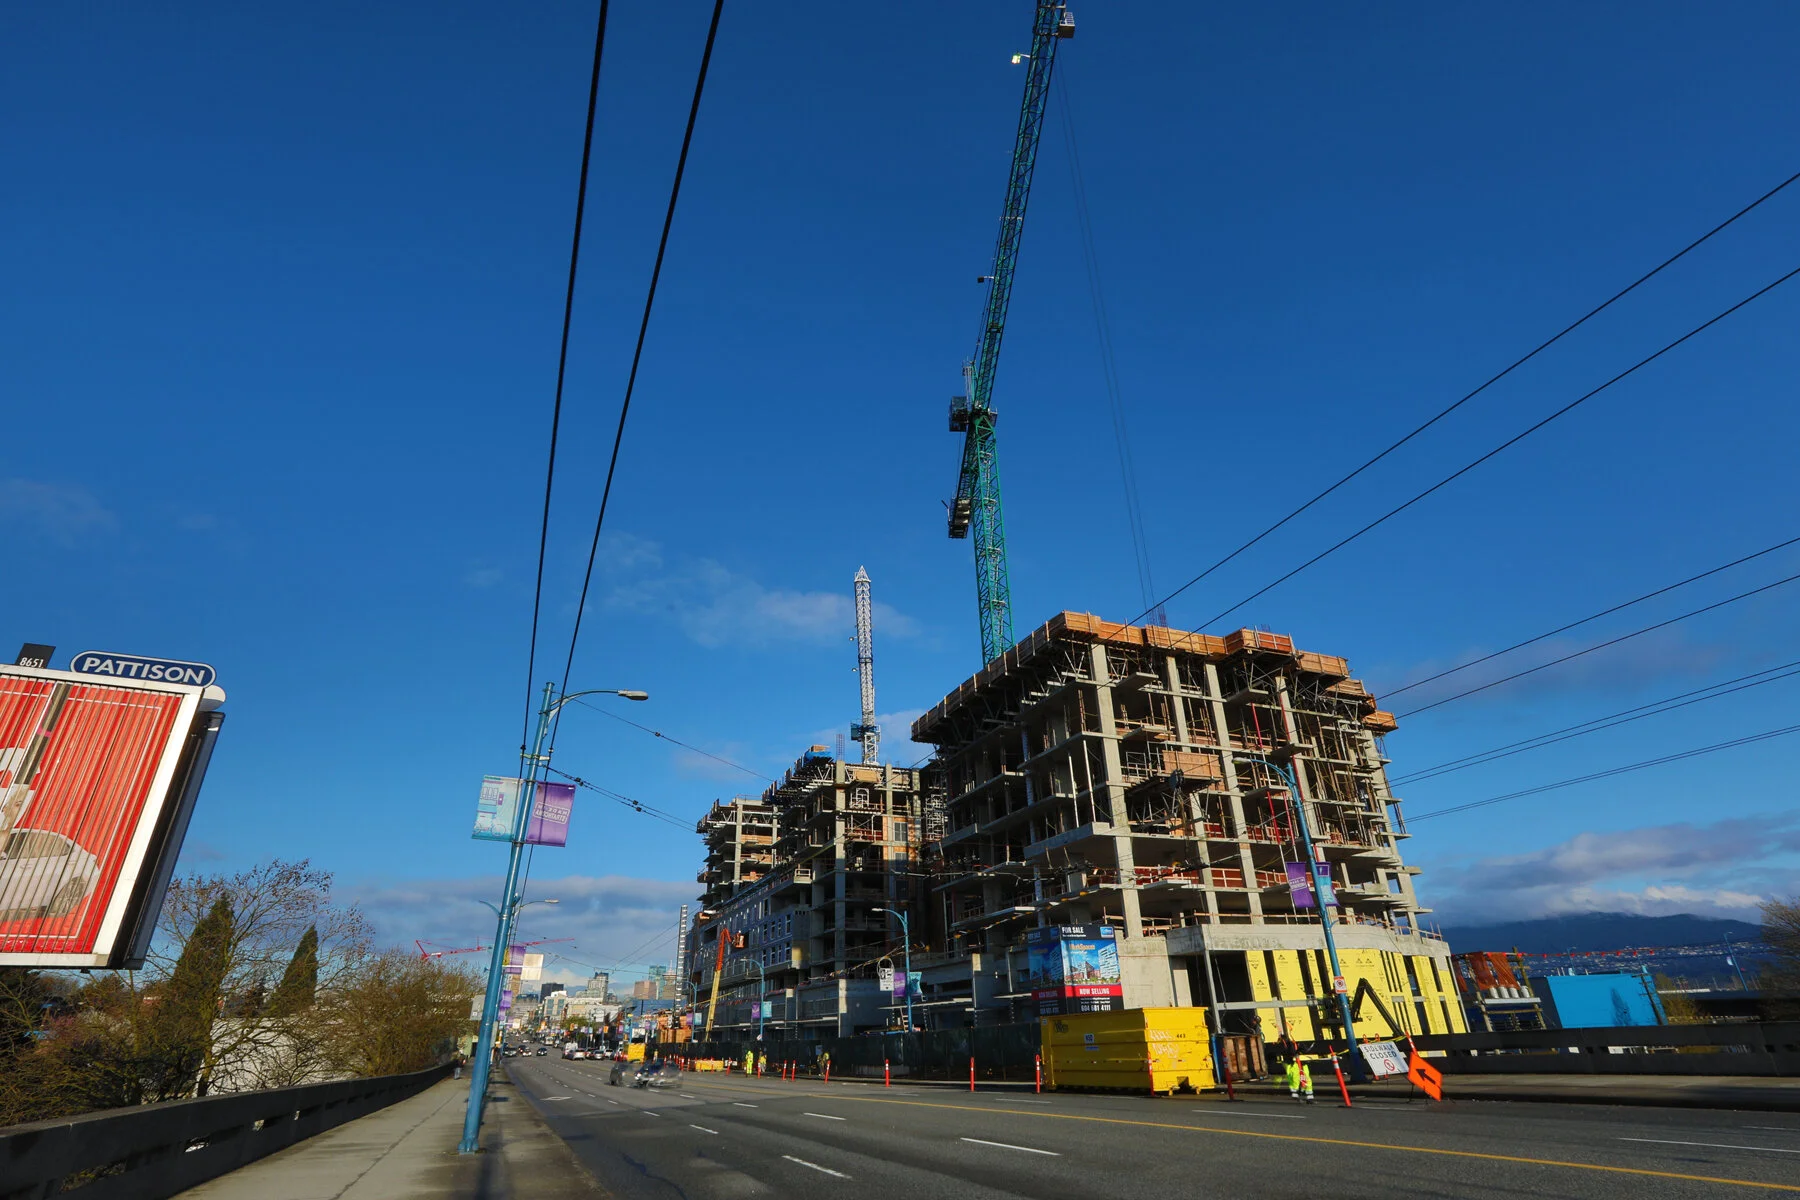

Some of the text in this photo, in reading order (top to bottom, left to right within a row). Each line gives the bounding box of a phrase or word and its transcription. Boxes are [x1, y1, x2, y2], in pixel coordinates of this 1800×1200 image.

[19, 656, 44, 669] 8651
[82, 657, 205, 684] PATTISON
[1370, 1051, 1397, 1059] CLOSED
